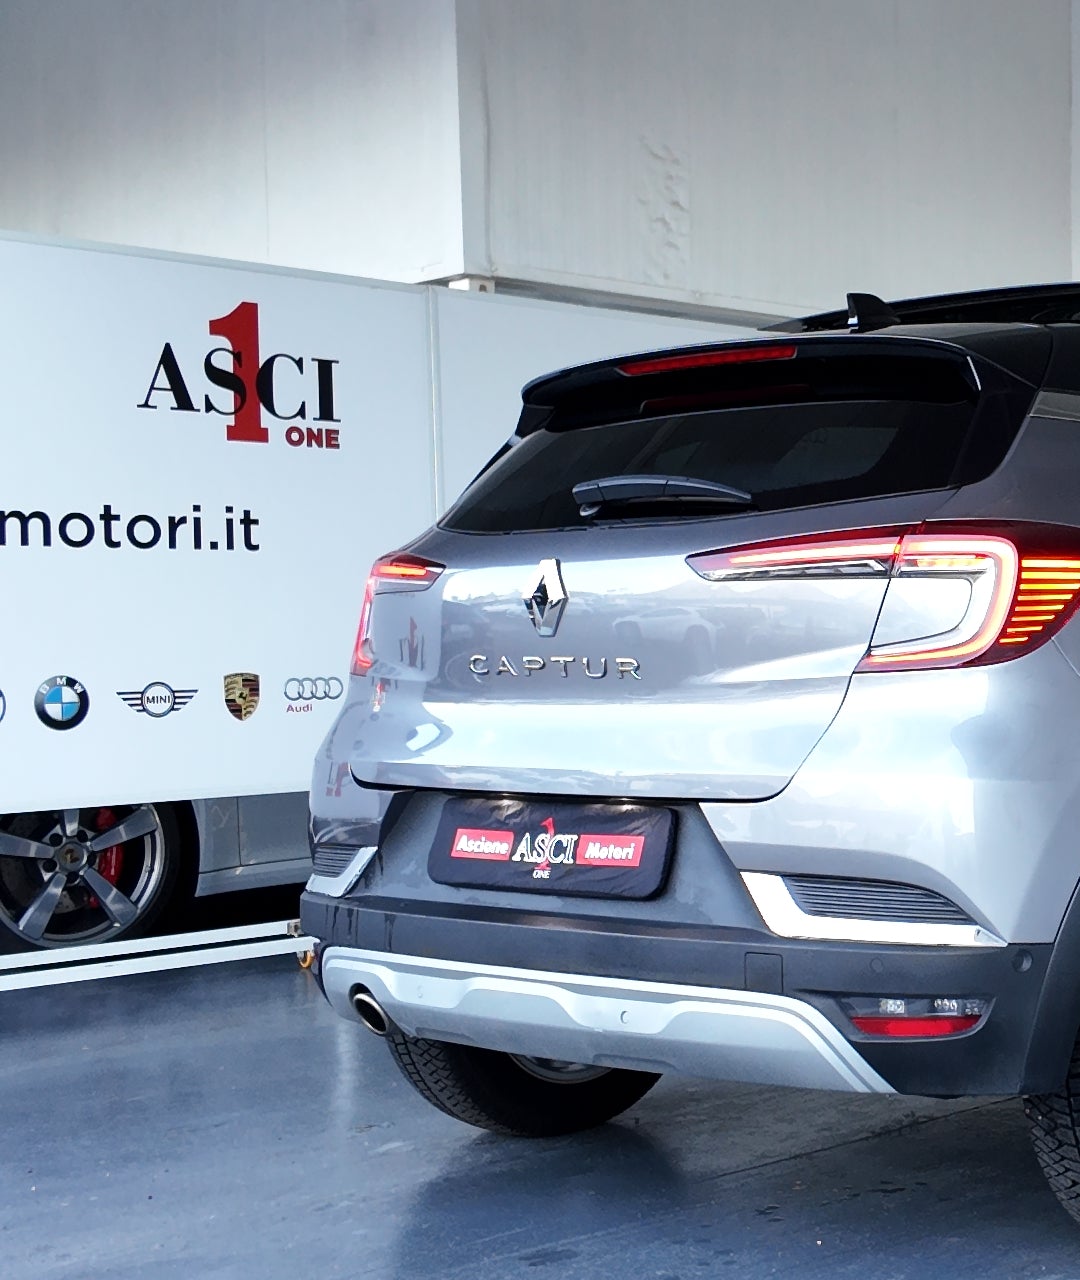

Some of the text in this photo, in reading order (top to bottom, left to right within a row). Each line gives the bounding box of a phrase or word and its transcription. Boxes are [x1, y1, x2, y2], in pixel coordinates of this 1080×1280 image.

[136, 342, 342, 423] ASCI
[285, 425, 341, 450] ONE
[0, 504, 261, 552] motori.it
[469, 654, 642, 681] CAPTUR
[144, 695, 172, 705] MINI
[286, 703, 313, 713] Audi
[456, 832, 636, 864] Ascione ASCI Motori
[532, 869, 551, 879] ONE
